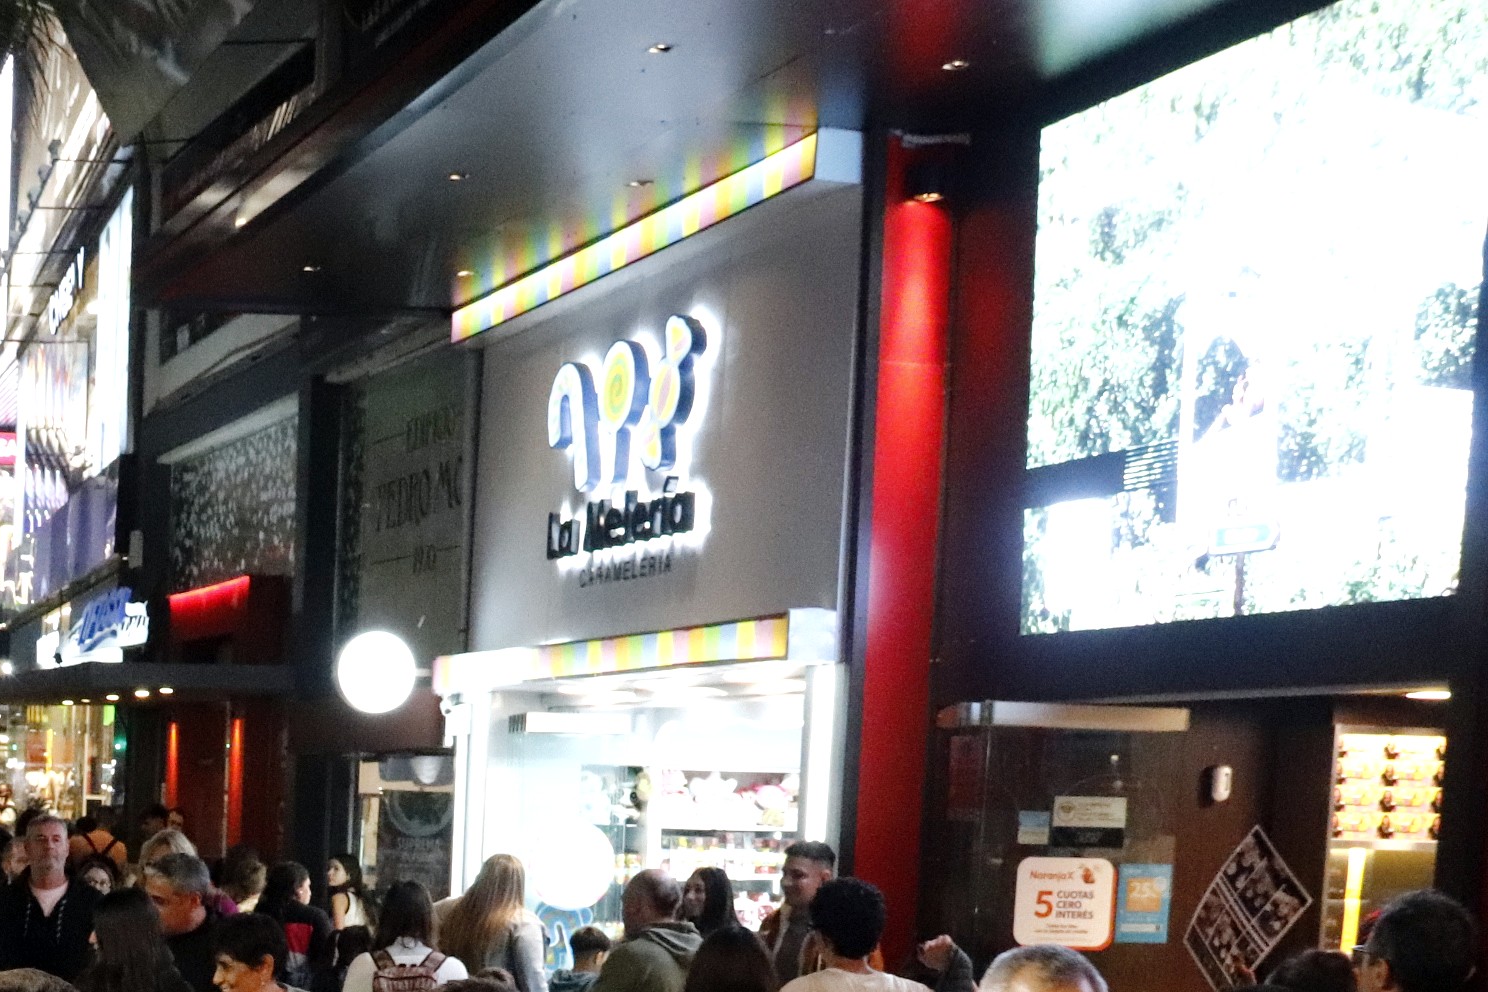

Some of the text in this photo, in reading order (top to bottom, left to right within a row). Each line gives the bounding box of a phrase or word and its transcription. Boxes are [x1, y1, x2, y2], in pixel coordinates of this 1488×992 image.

[1056, 890, 1094, 899] CUOTAS
[1034, 890, 1053, 918] 5
[1056, 901, 1082, 909] CERO
